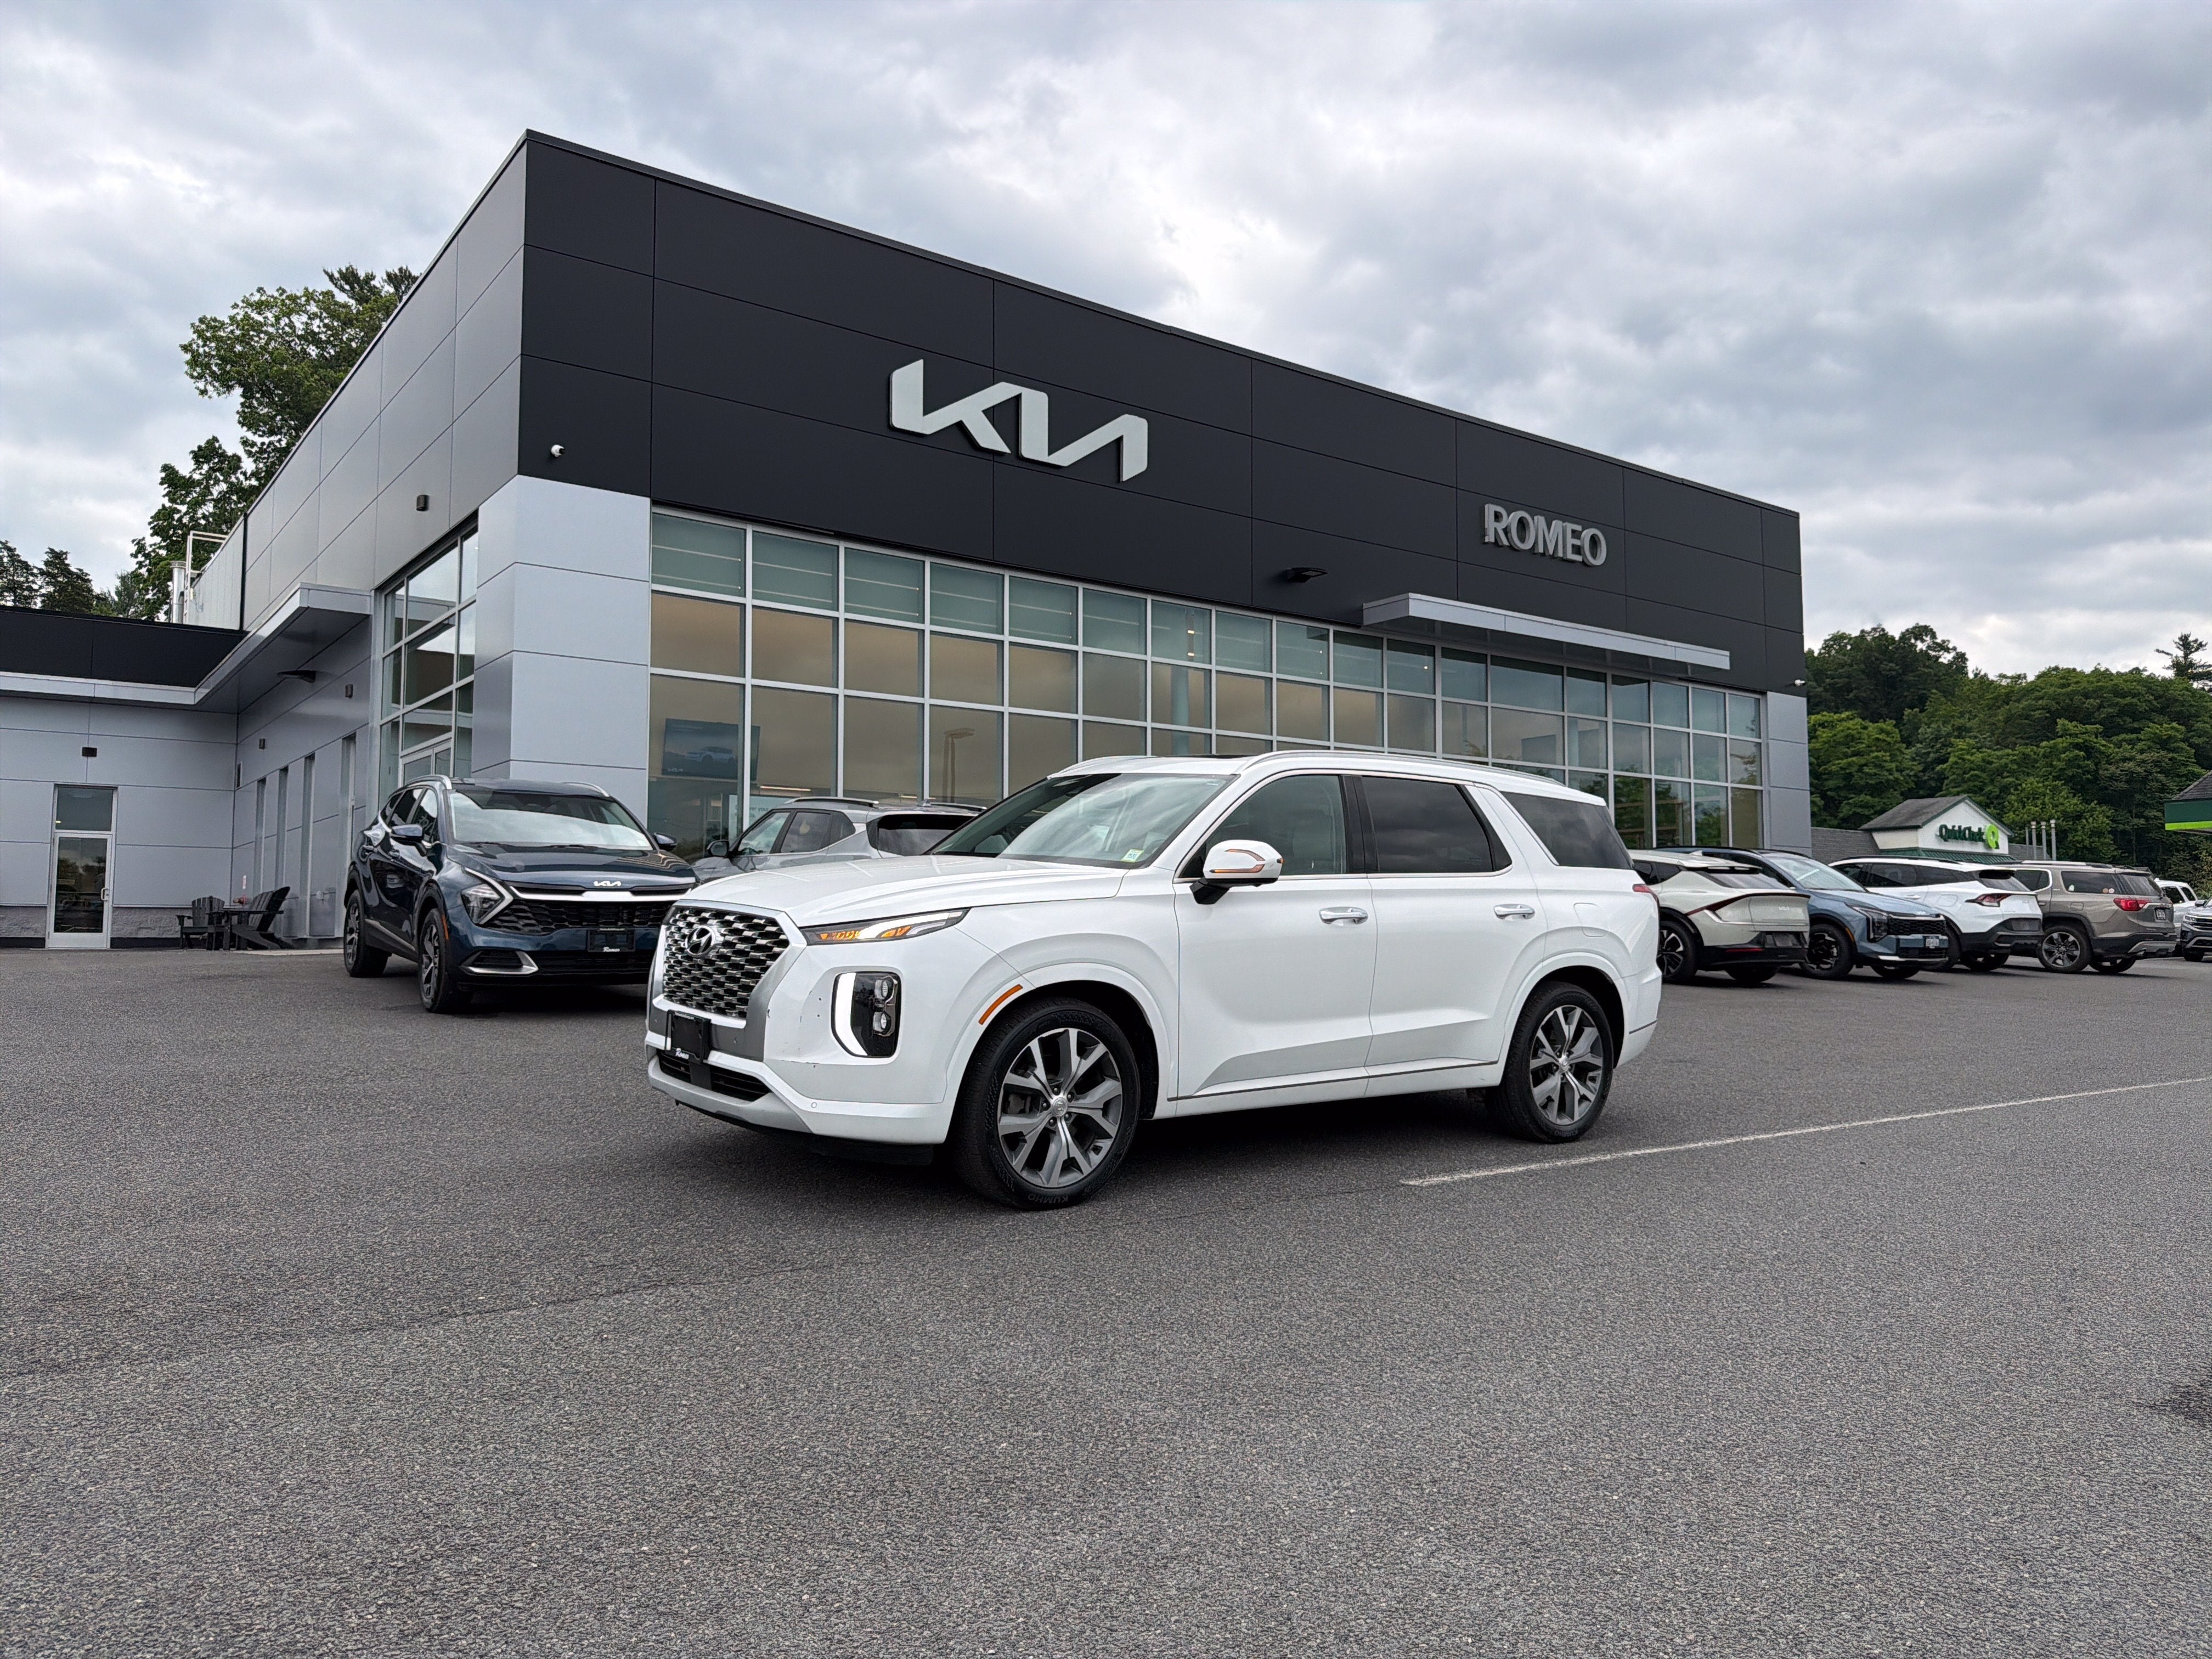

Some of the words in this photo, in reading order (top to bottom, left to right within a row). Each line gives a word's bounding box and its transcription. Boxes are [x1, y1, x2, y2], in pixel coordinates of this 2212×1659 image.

[890, 359, 1148, 482] KIA
[1485, 503, 1607, 566] ROMEO
[1028, 1193, 1069, 1204] KUMHO
